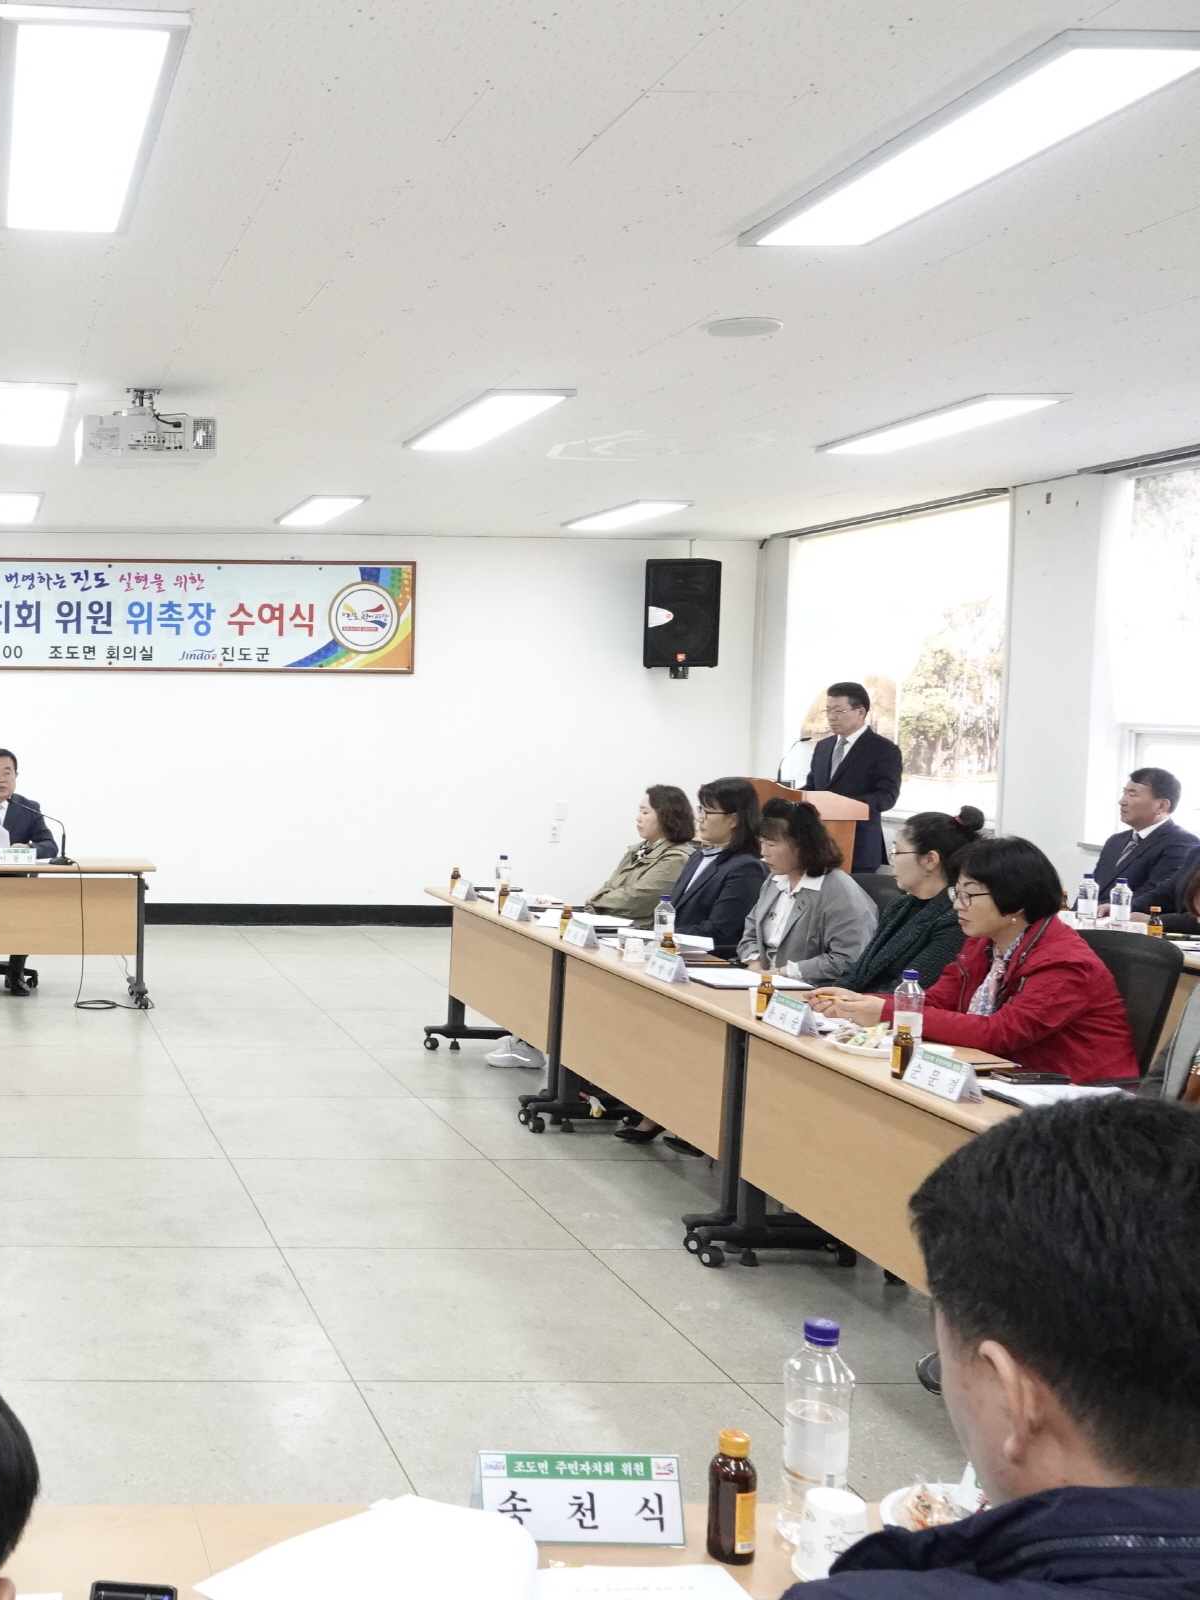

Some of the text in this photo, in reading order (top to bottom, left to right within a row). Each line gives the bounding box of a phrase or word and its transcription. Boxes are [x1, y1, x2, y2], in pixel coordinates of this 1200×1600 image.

[4, 571, 67, 591] 번영하는
[70, 569, 110, 592] 진도
[118, 571, 166, 593] 실현을
[173, 572, 206, 593] 위한
[55, 600, 113, 635] 위원
[126, 600, 217, 637] 위촉장
[227, 602, 315, 638] 수여식
[48, 646, 154, 662] 조도면 회의실
[221, 646, 271, 662] 진도군
[513, 1460, 549, 1475] 조도면
[555, 1460, 615, 1476] 주민자치회
[621, 1462, 646, 1477] 위원
